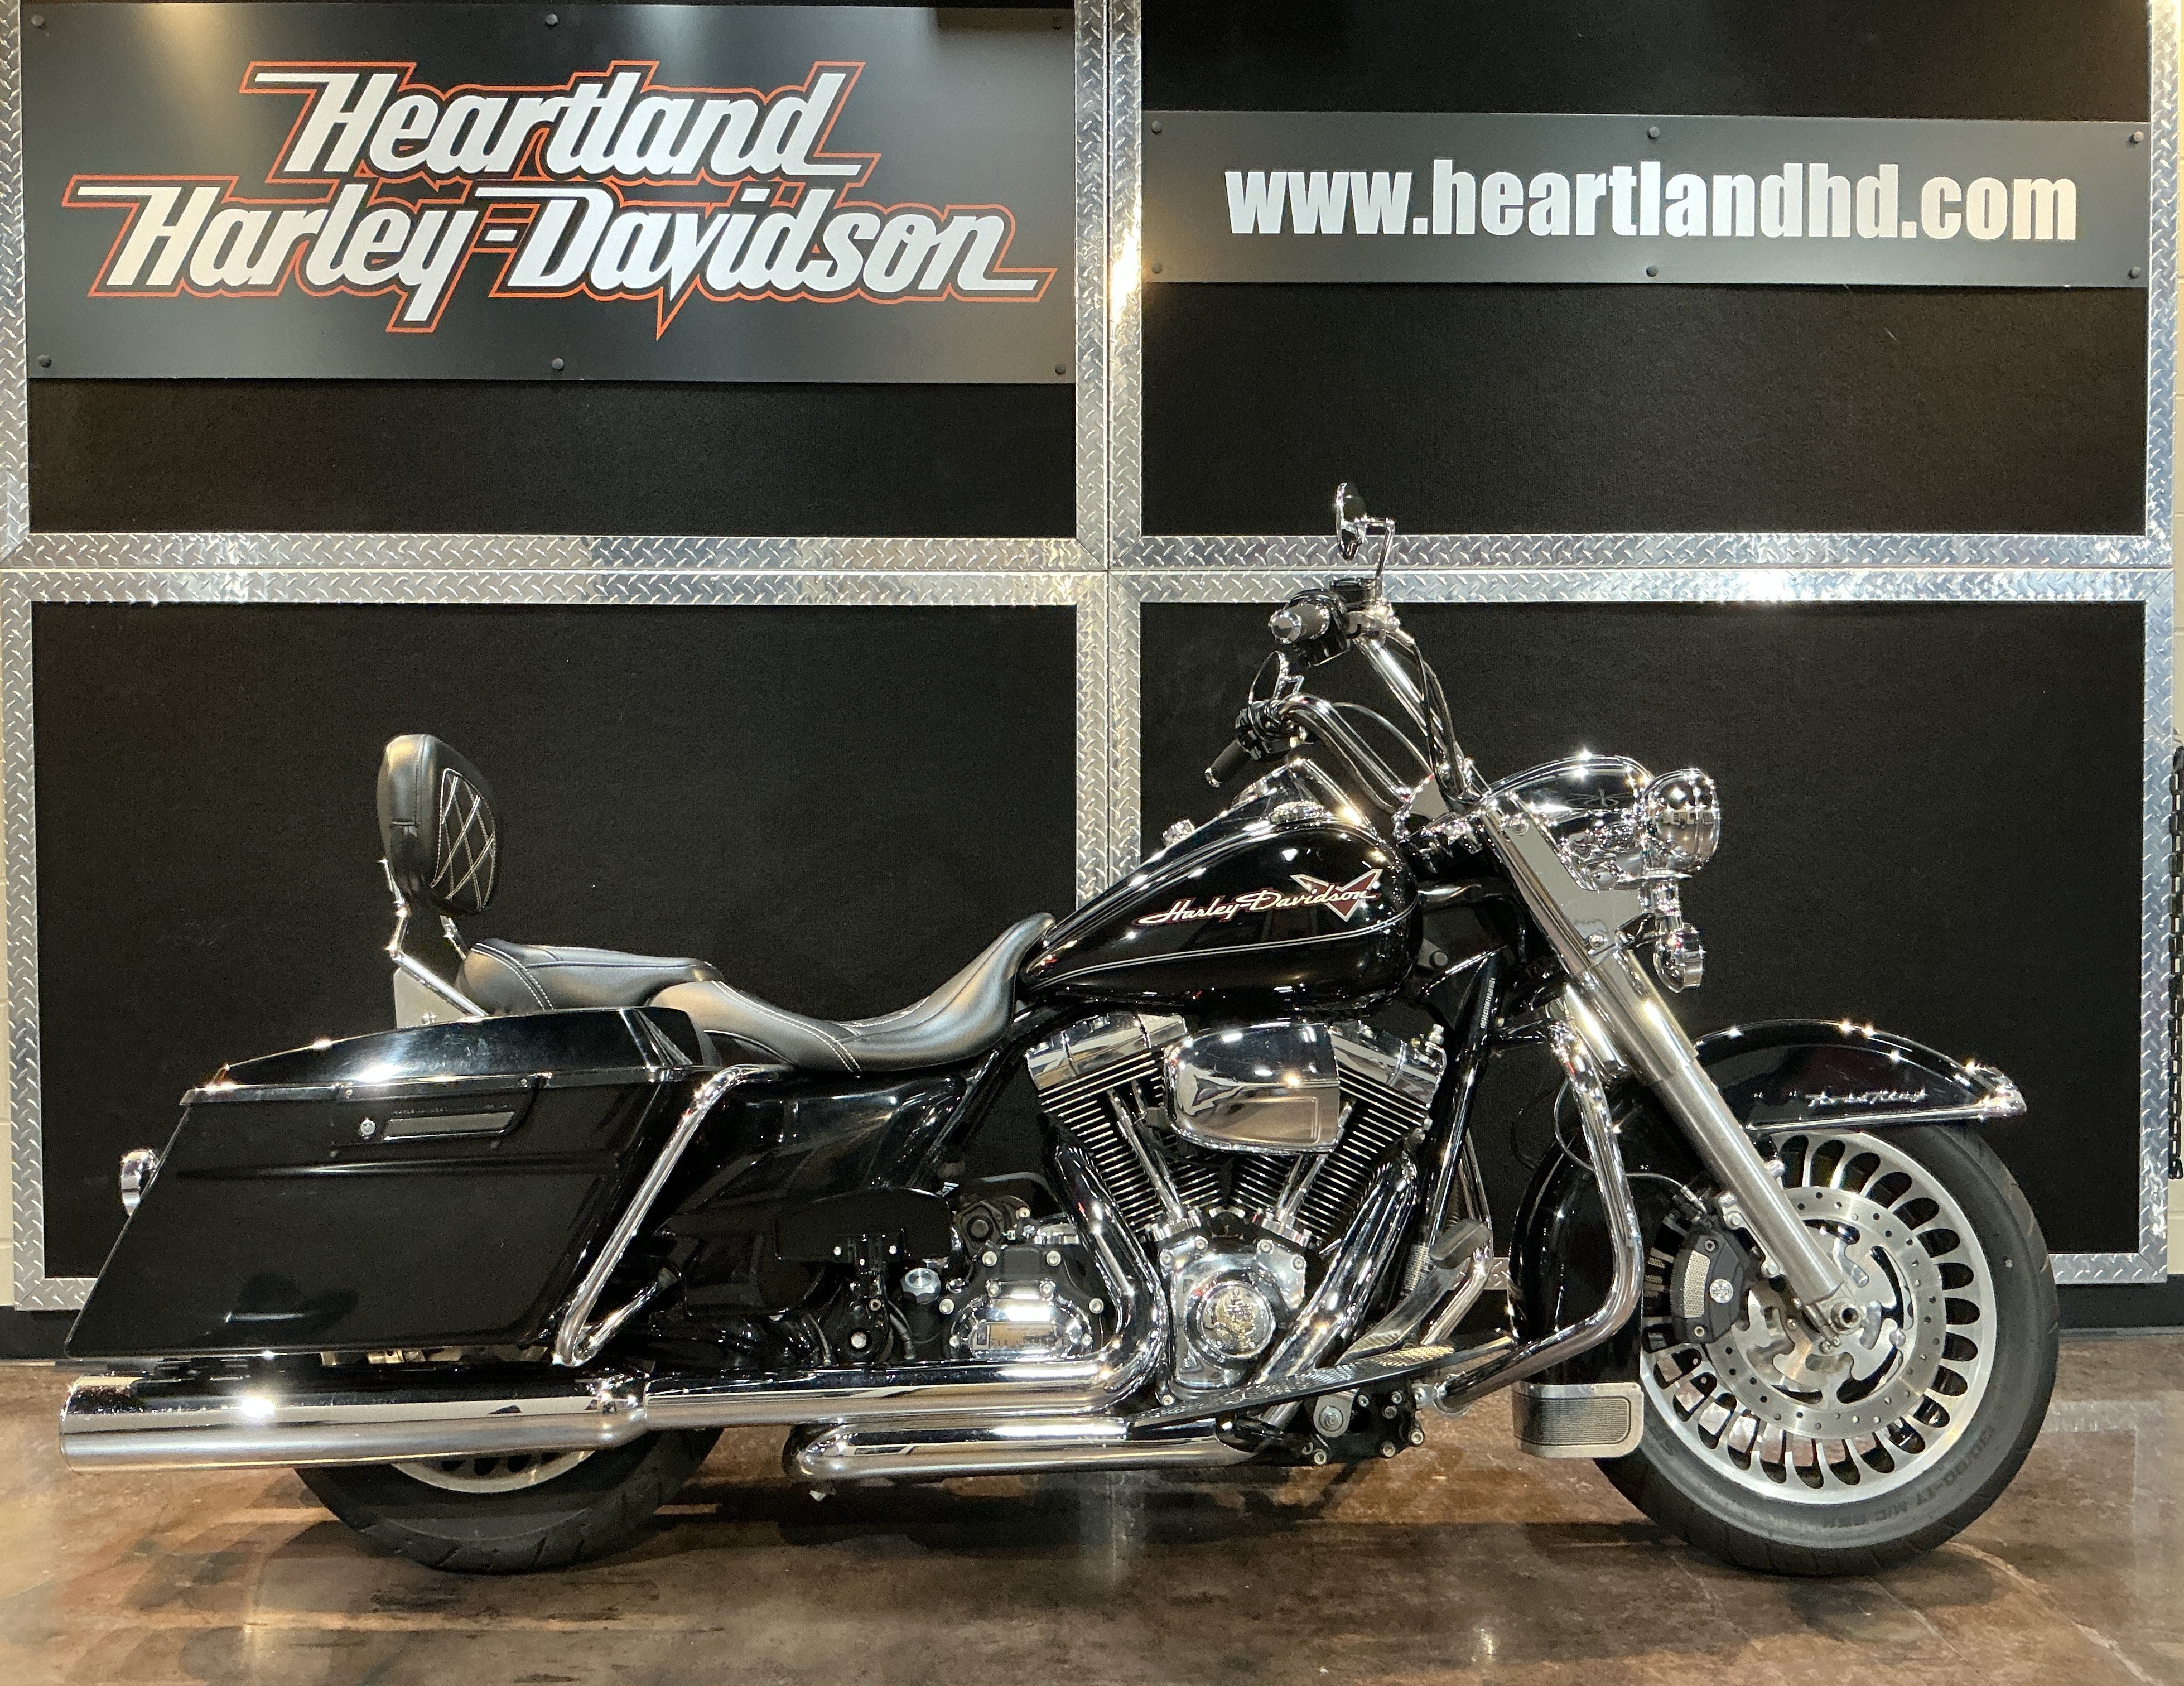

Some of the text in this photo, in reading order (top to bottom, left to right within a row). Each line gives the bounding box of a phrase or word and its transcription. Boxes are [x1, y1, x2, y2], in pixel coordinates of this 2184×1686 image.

[254, 71, 864, 176] Heartland
[1224, 158, 2078, 244] www.heartlandhd.com
[76, 184, 1039, 322] Harley-Davidson
[1137, 884, 1378, 924] Harley-Davidson
